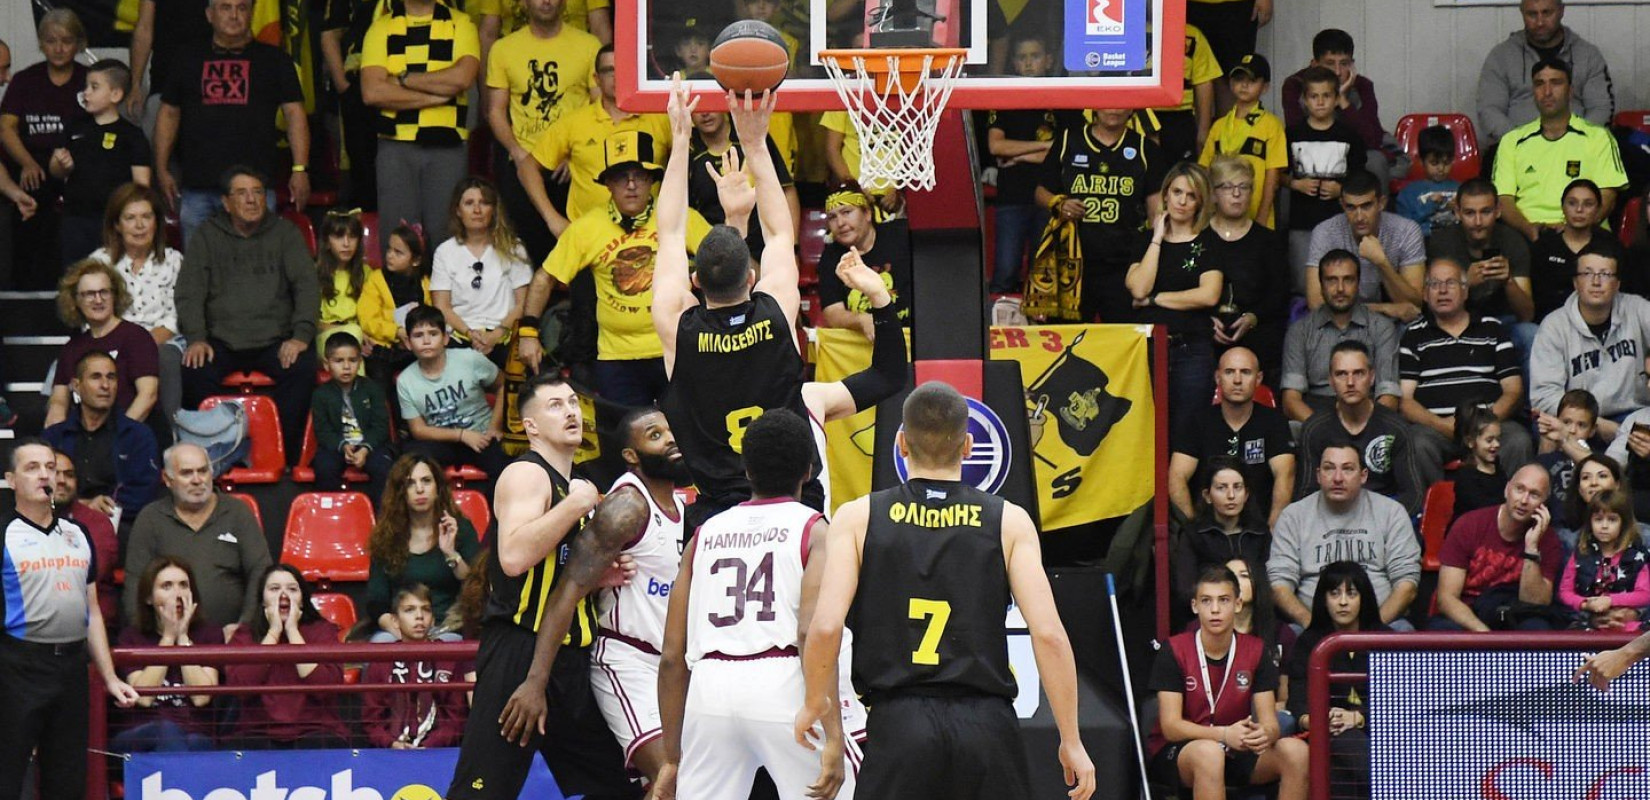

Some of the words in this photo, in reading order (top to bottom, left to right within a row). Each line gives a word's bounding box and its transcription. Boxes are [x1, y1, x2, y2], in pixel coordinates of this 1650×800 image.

[1097, 25, 1122, 33] EKO
[1071, 173, 1134, 196] ARIS
[1082, 196, 1120, 223] 23
[698, 319, 774, 353] ΜΙΛΟΣΕΒΙΤΣ
[1039, 330, 1064, 353] 3
[1571, 349, 1600, 377] NEW
[889, 502, 982, 528] ΦΛΙΩΝΗΣ
[703, 527, 789, 551] HAMMONDS
[708, 551, 776, 628] 34
[909, 598, 951, 665] 7
